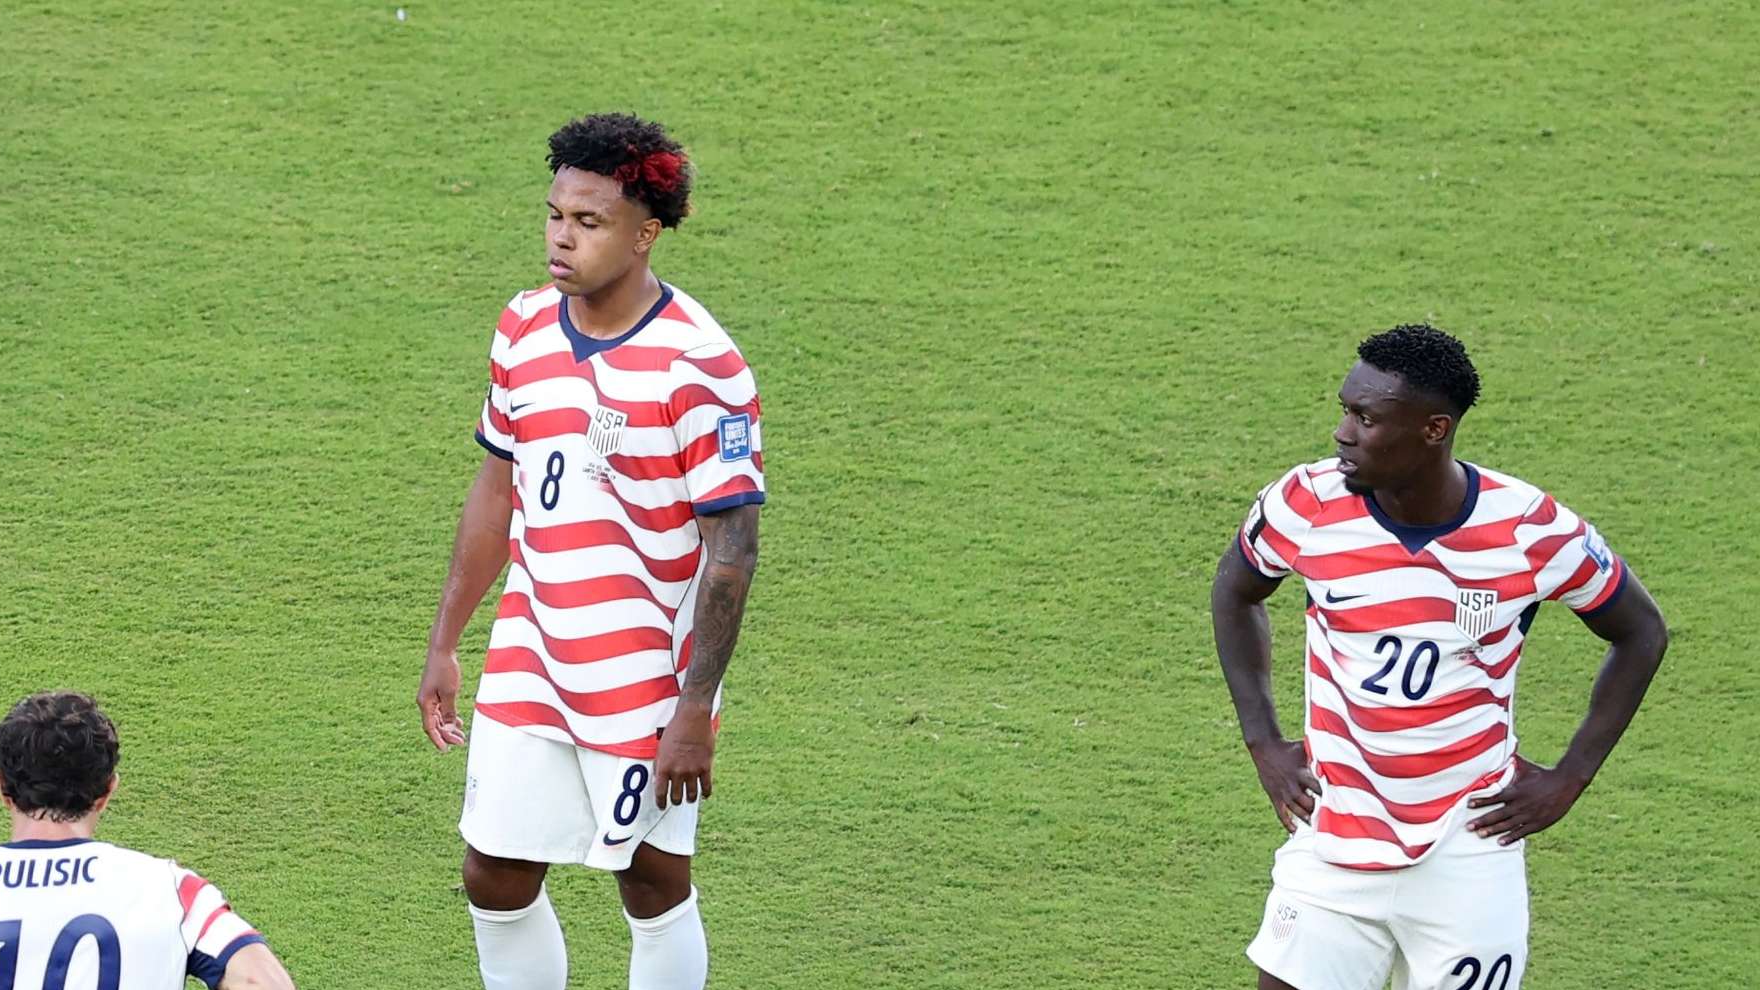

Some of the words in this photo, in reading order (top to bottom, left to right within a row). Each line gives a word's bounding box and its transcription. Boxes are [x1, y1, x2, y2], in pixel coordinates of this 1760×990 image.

[595, 408, 624, 430] USA
[540, 451, 565, 511] 8
[1460, 592, 1494, 611] USA
[1361, 636, 1440, 700] 20
[613, 763, 648, 826] 8
